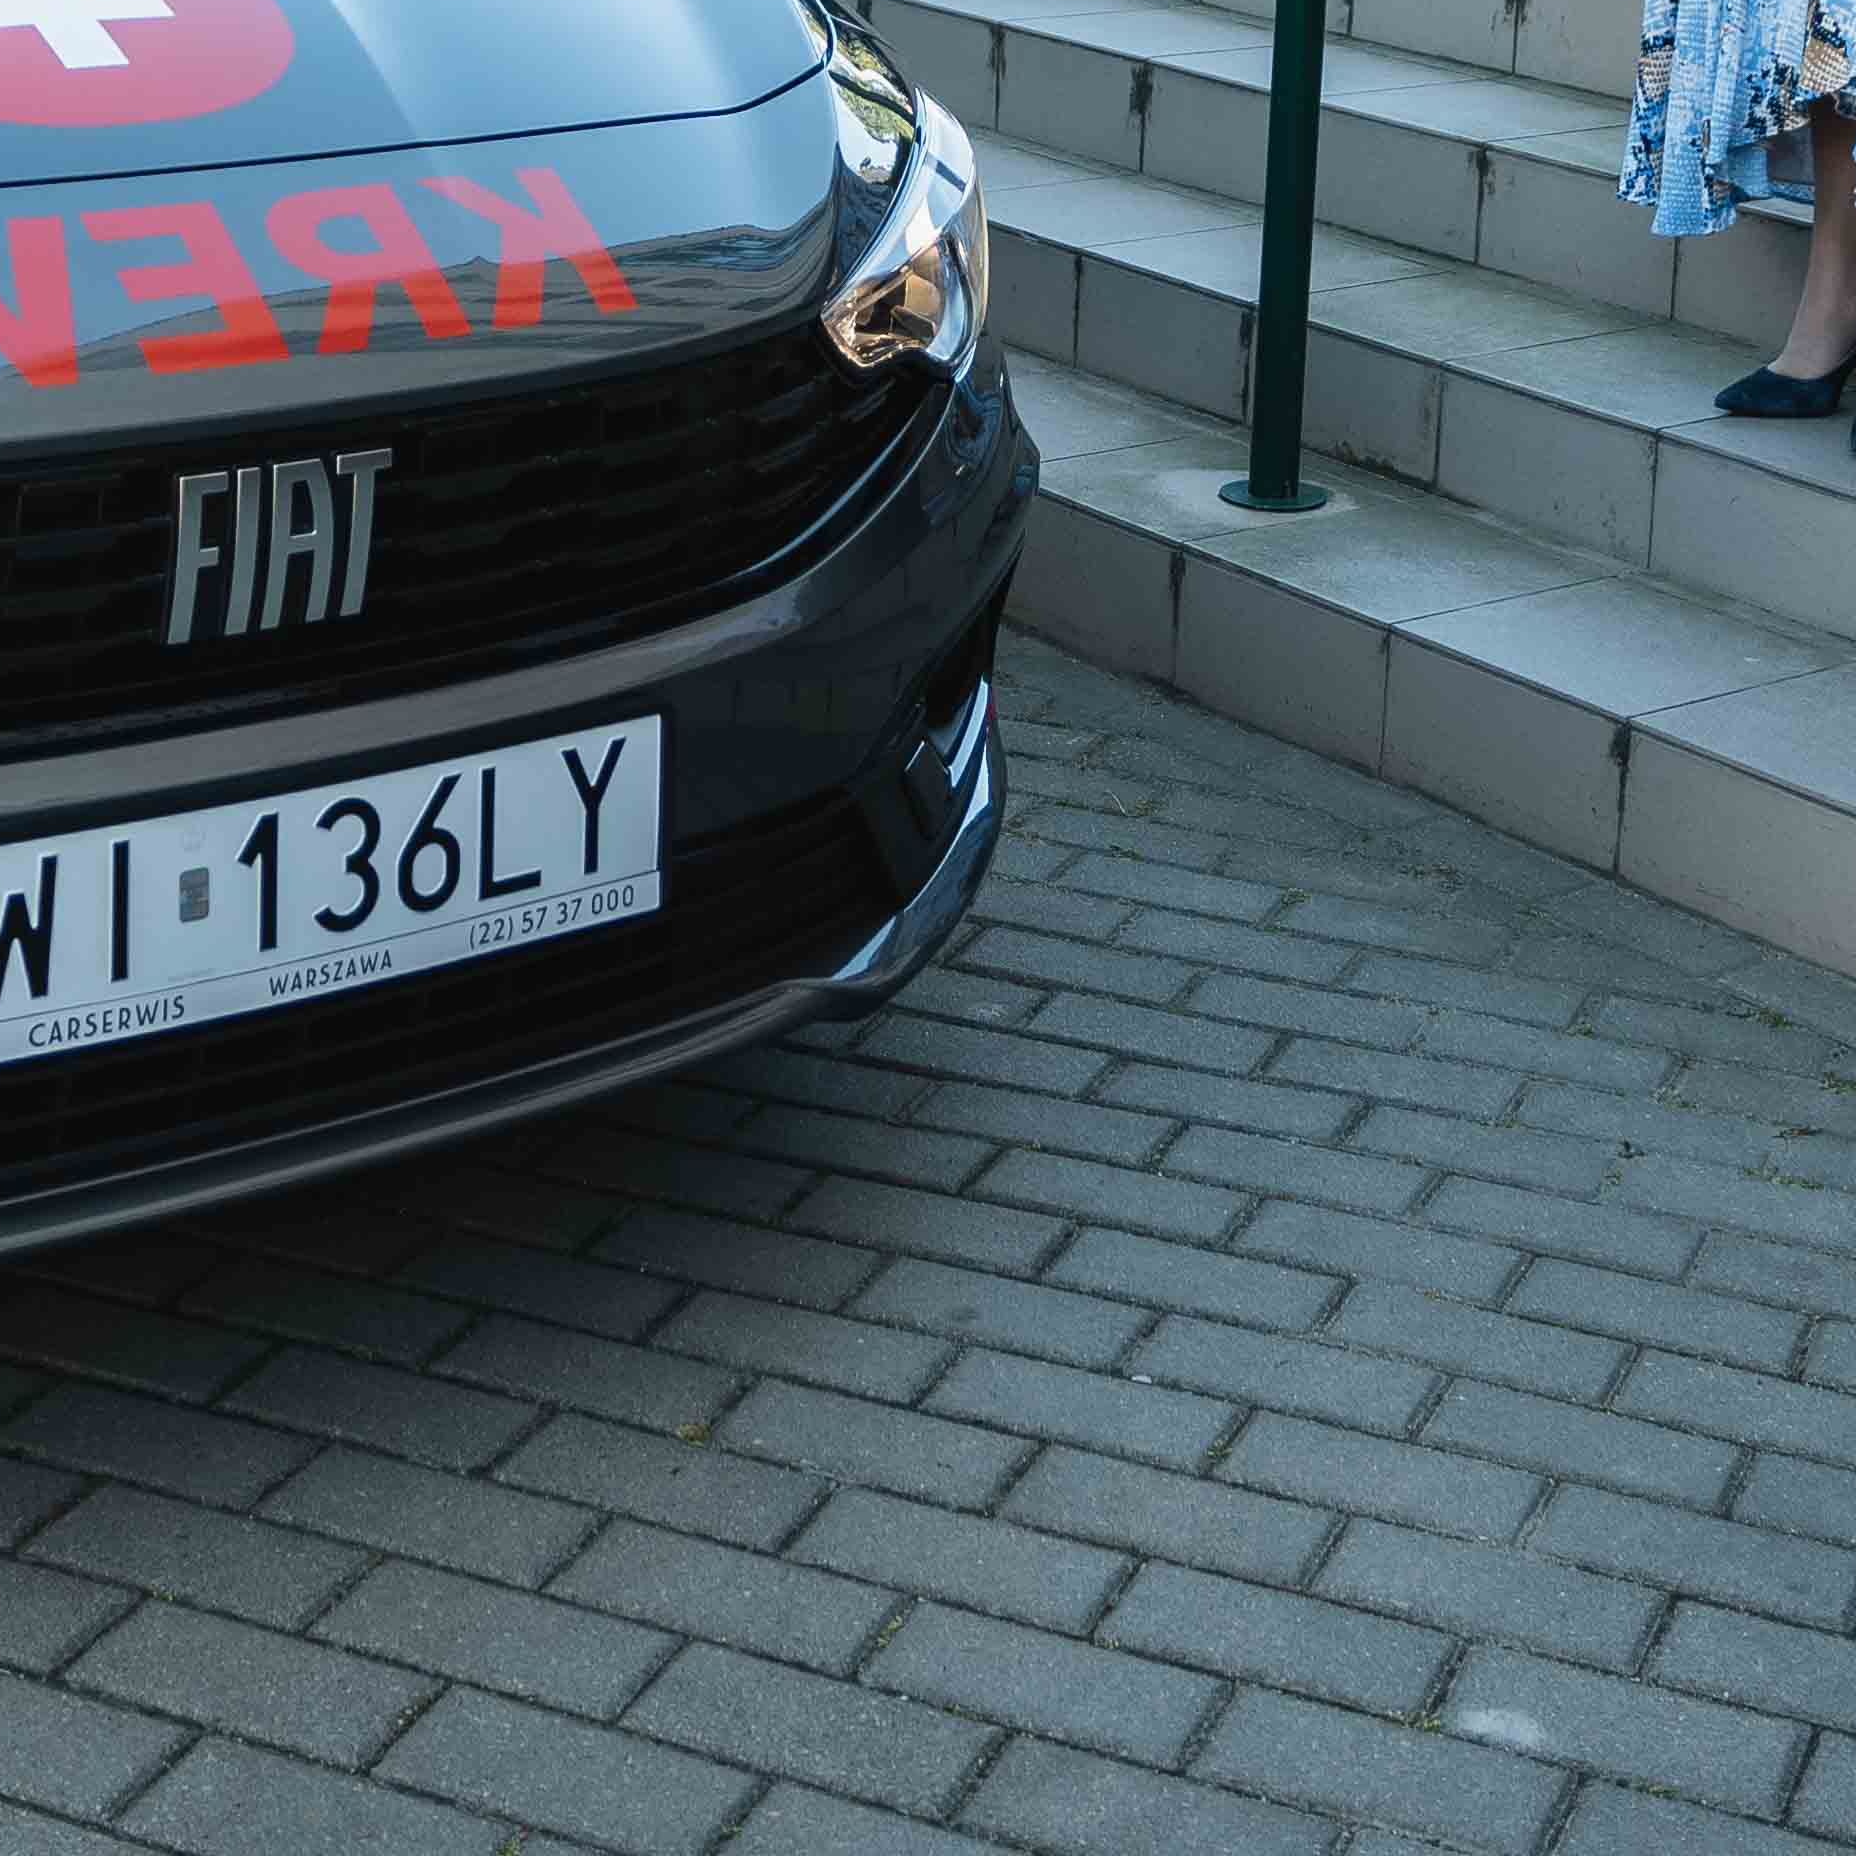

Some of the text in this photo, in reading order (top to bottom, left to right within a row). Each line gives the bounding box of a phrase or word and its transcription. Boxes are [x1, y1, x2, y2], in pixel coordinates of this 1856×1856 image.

[167, 447, 393, 645] FIAT
[236, 736, 627, 953] 136LY
[28, 884, 636, 1048] CARSERWIS WARSZAWA (22) 57 37 000
